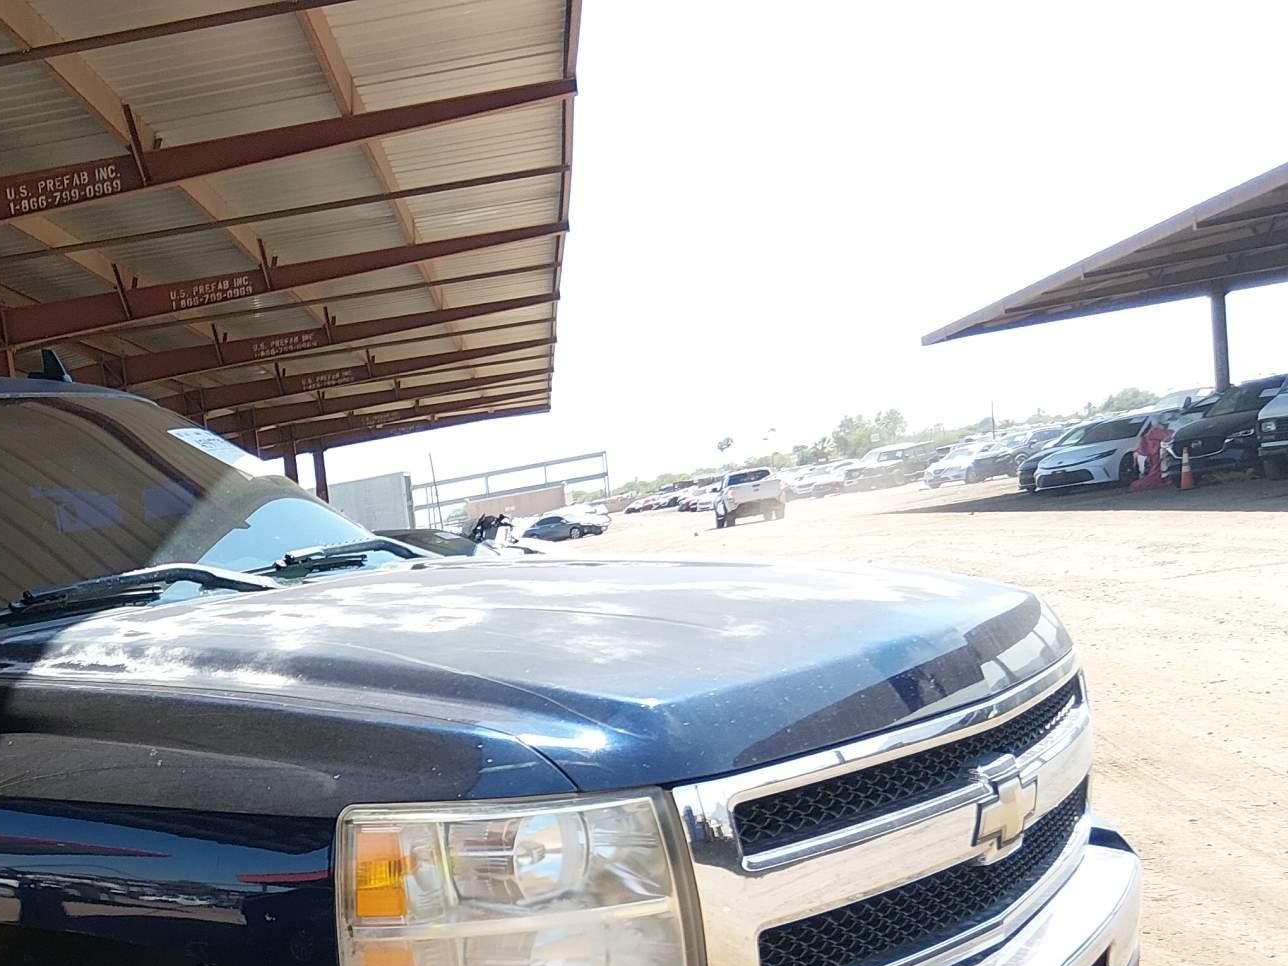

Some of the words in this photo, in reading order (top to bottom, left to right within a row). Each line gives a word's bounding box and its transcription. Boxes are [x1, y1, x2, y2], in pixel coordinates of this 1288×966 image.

[6, 185, 32, 200] U.S.
[38, 172, 89, 193] PREFAB
[95, 165, 121, 181] INC.
[9, 180, 121, 215] 1-866-799-0969
[192, 280, 229, 296] PREFAB
